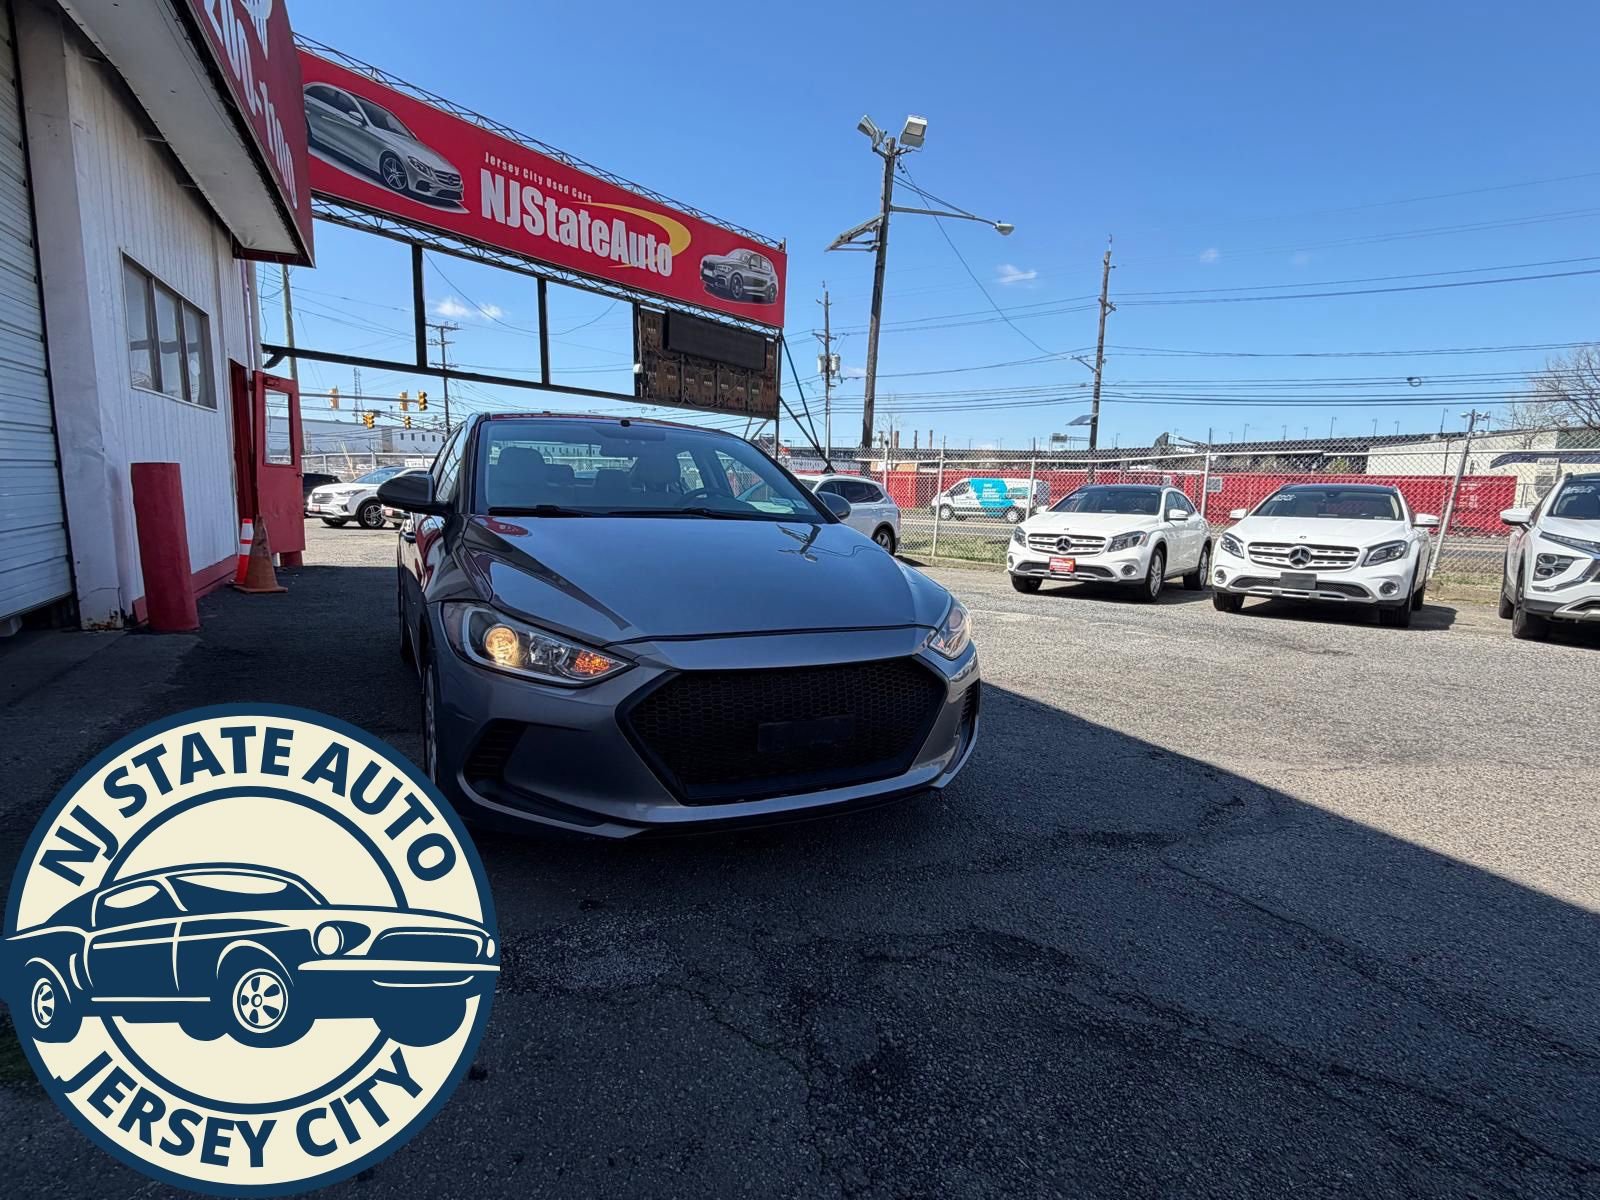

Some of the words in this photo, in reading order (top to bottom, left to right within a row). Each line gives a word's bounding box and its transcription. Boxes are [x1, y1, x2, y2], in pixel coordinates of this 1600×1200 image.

[484, 151, 520, 176] Jersey
[523, 167, 544, 187] City
[546, 176, 569, 195] Used
[571, 187, 593, 204] Cars
[480, 168, 673, 278] NJStateAuto
